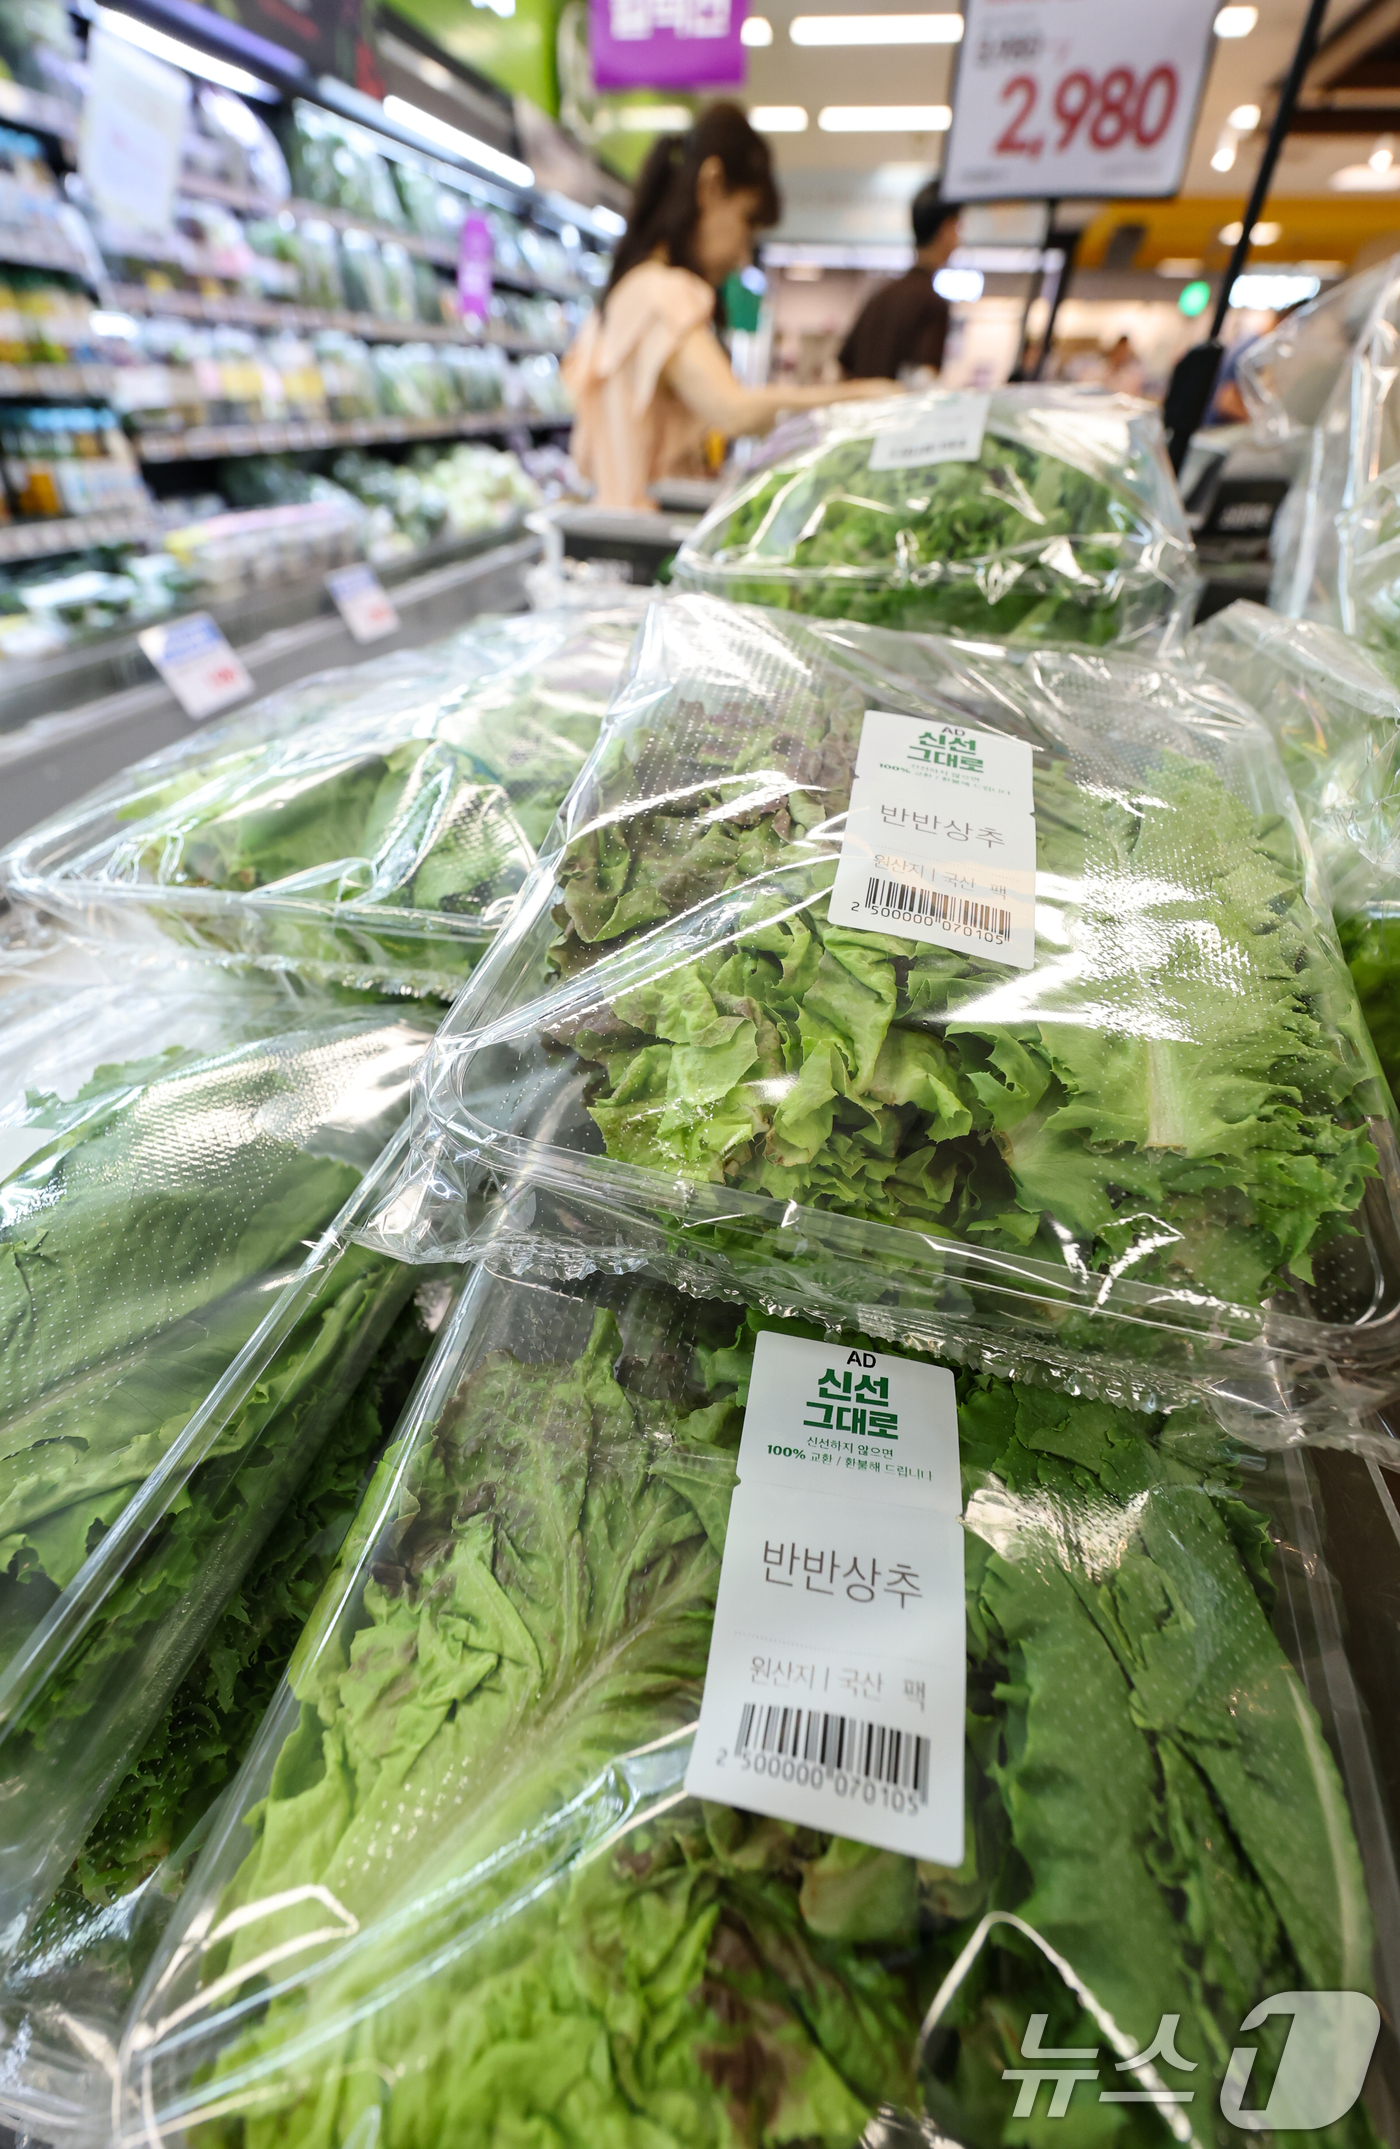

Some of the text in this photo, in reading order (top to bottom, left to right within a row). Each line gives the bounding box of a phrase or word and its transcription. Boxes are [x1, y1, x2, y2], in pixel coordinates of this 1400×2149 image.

[993, 63, 1179, 162] 2,980
[919, 732, 976, 755] 신선
[941, 726, 966, 736] AD
[879, 763, 911, 774] 100%
[907, 745, 984, 773] 그대로
[880, 804, 1005, 848] 반반상추
[873, 854, 924, 879] 원산지
[942, 871, 975, 892] 국산
[989, 883, 1007, 900] 팩
[851, 901, 1004, 945] 2 500000 070105
[846, 1350, 877, 1368] AD
[818, 1368, 889, 1407] 신선
[803, 1401, 898, 1440] 그대로
[767, 1444, 806, 1460] 100%
[810, 1452, 833, 1466] 교환
[845, 1457, 880, 1473] 환불해
[884, 1464, 932, 1481] 드립니다
[806, 1436, 893, 1460] 신선하지 않으면
[763, 1540, 923, 1610] 반반상추
[750, 1655, 815, 1690] 원산지
[839, 1666, 883, 1702] 국산
[903, 1677, 926, 1713] 팩
[715, 1747, 919, 1816] 2 500000 070105
